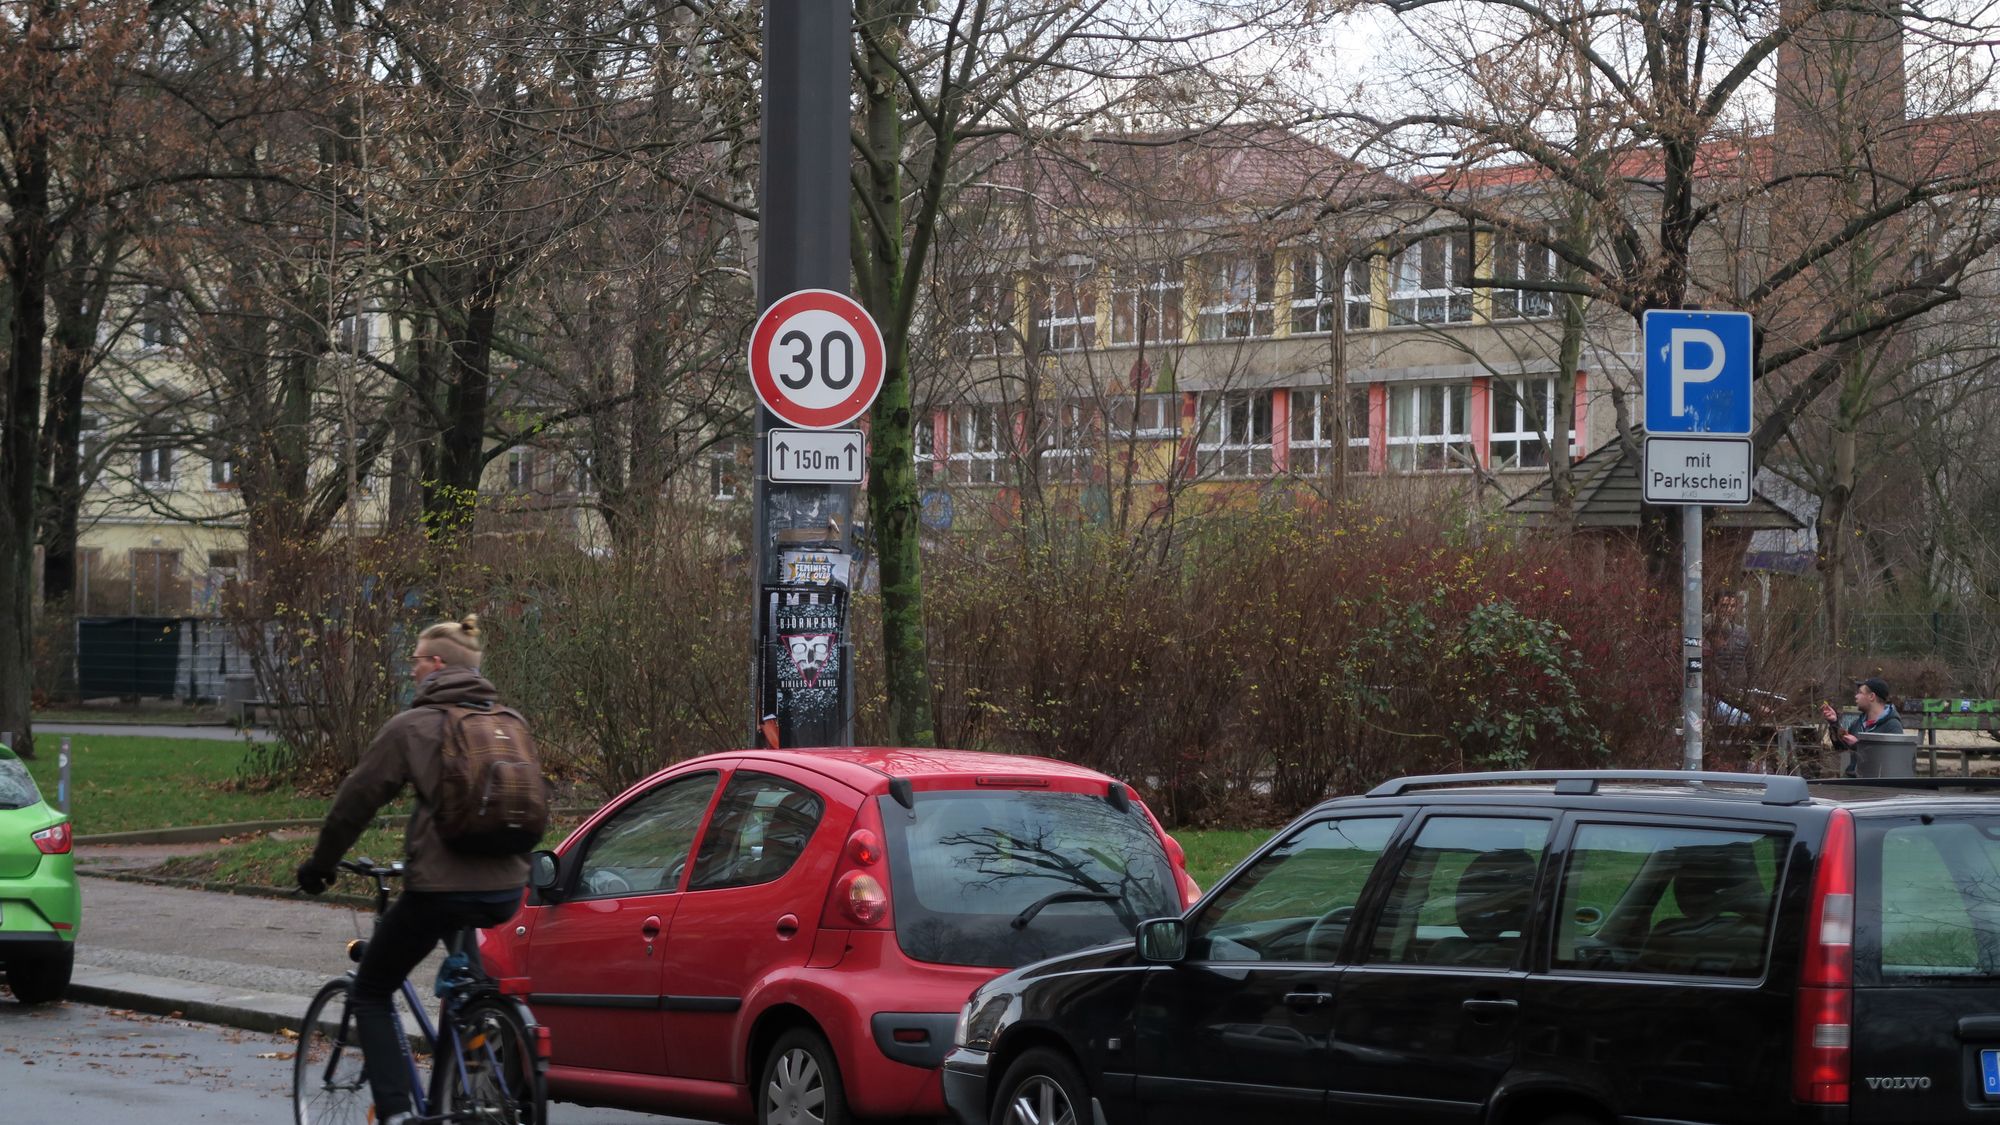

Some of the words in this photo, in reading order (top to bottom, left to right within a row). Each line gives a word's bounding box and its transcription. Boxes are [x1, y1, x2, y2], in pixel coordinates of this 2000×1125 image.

[780, 330, 854, 390] 30
[1671, 328, 1726, 417] P
[794, 449, 822, 470] 150
[825, 455, 839, 470] m
[1686, 452, 1711, 468] mit
[1654, 472, 1742, 489] Parkschein
[795, 563, 832, 573] FEMINIST
[1865, 1076, 1932, 1090] VOLVO
[1989, 1077, 1996, 1087] D
